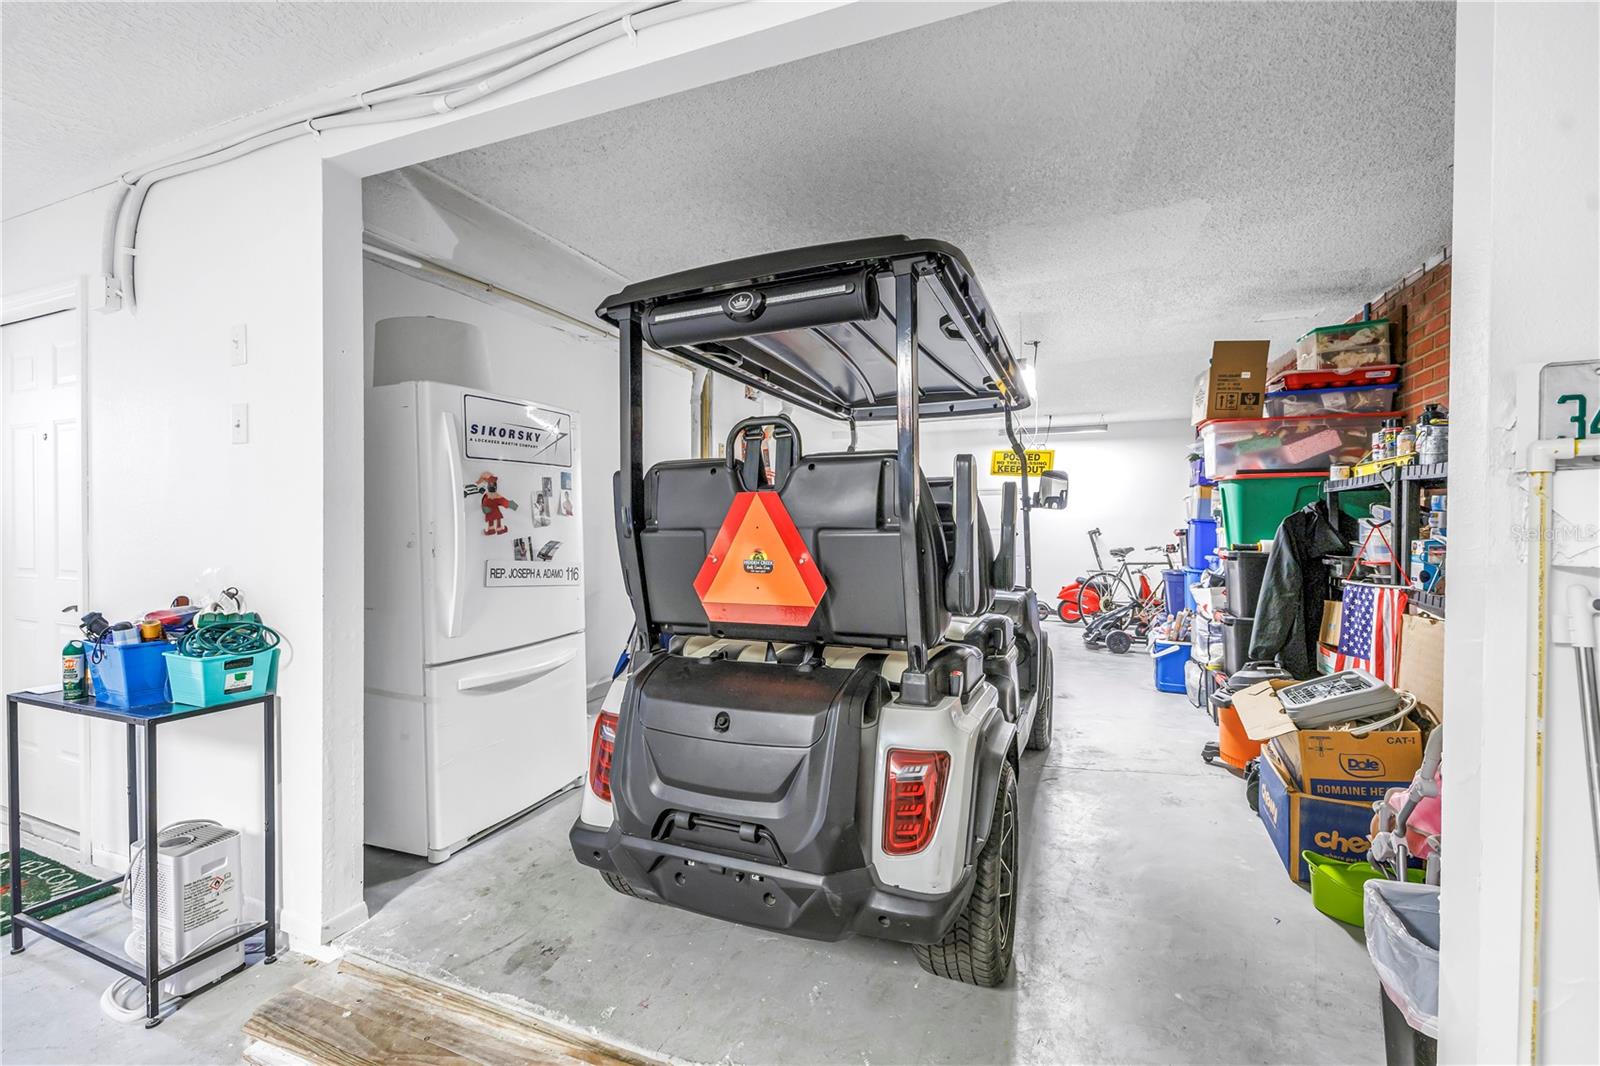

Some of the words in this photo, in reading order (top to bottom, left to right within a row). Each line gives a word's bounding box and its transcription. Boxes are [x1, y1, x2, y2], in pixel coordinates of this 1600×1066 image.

[470, 424, 541, 442] SIKORSKY
[997, 465, 1022, 473] KEEP
[490, 568, 508, 579] REP.
[508, 568, 535, 579] JOSEPH
[543, 569, 564, 579] ADAMO
[566, 566, 579, 581] 116
[1347, 758, 1379, 771] Dole
[1317, 784, 1367, 796] ROMAINE
[1370, 787, 1388, 797] HE
